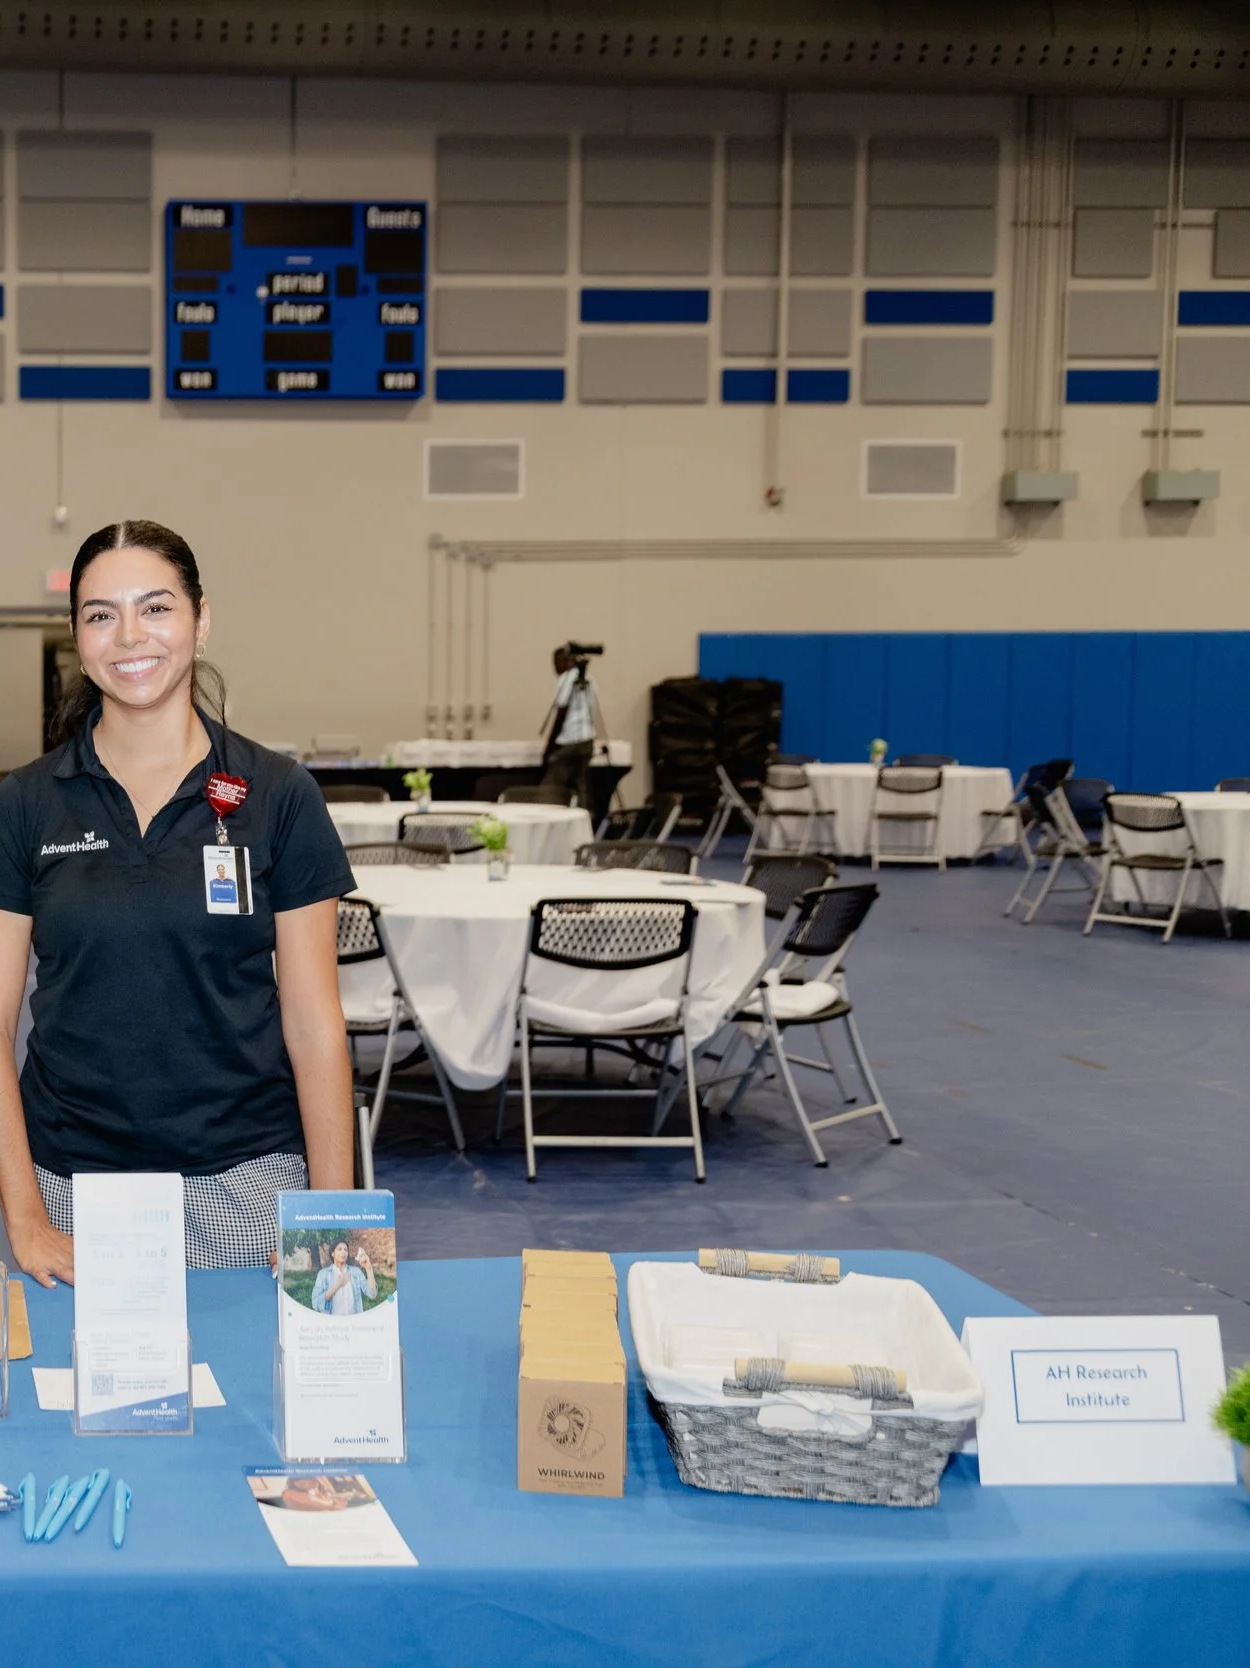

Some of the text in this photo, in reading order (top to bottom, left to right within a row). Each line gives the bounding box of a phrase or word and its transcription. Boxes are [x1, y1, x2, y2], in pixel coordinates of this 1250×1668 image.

[181, 205, 225, 227] Home
[366, 206, 422, 228] Guests
[273, 273, 324, 295] period
[177, 302, 215, 323] fouls
[273, 301, 324, 324] player
[381, 303, 419, 324] fouls
[180, 372, 212, 388] won
[278, 372, 318, 392] game
[384, 373, 416, 389] won
[40, 838, 109, 856] AdventHealth
[1045, 1363, 1148, 1381] AH Research
[1066, 1392, 1131, 1407] Institute
[333, 1435, 389, 1445] AdventHealth
[537, 1467, 605, 1480] WHIRLWIND
